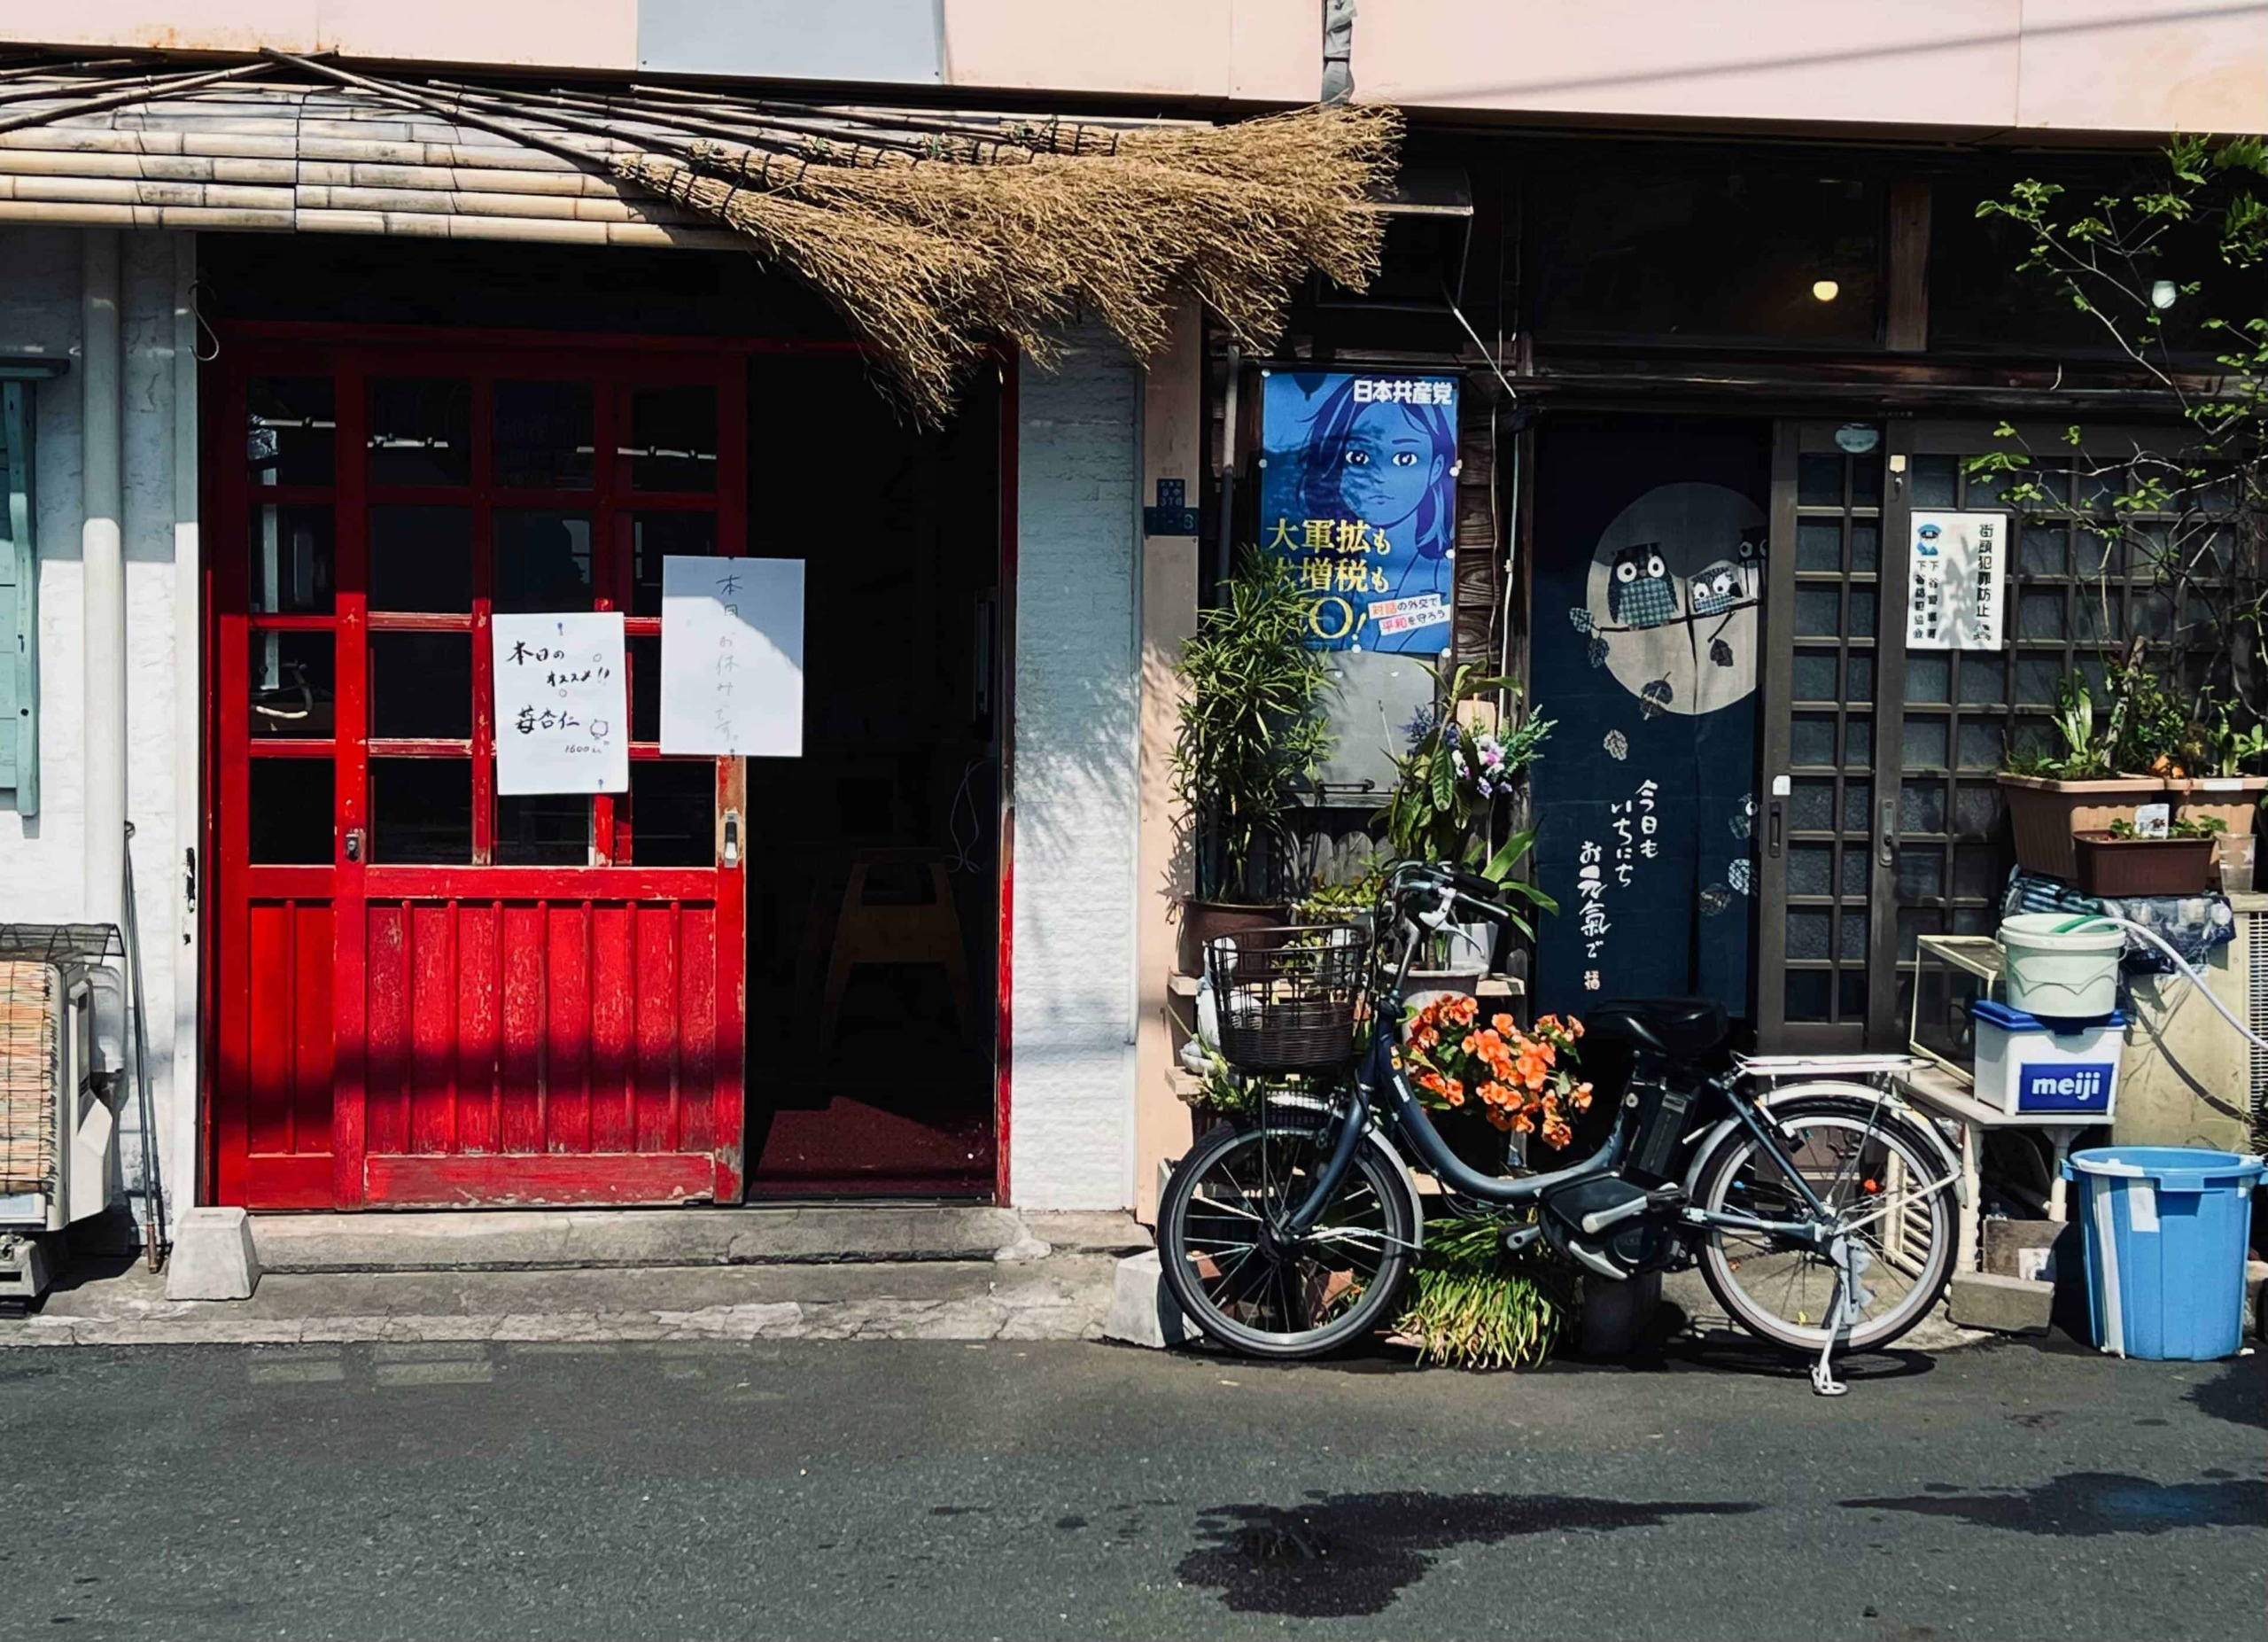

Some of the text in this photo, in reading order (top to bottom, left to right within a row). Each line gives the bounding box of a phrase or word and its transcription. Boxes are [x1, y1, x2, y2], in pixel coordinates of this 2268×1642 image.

[1354, 379, 1453, 405] 日本共産党
[1266, 518, 1391, 556] 大軍拡も
[1977, 523, 1994, 618] 街頭犯罪防止
[1299, 595, 1367, 642] O!
[506, 640, 565, 665] 本日の
[1635, 778, 1659, 859] 今日も
[1611, 799, 1634, 888] いちにち
[2031, 1071, 2101, 1101] meiji
